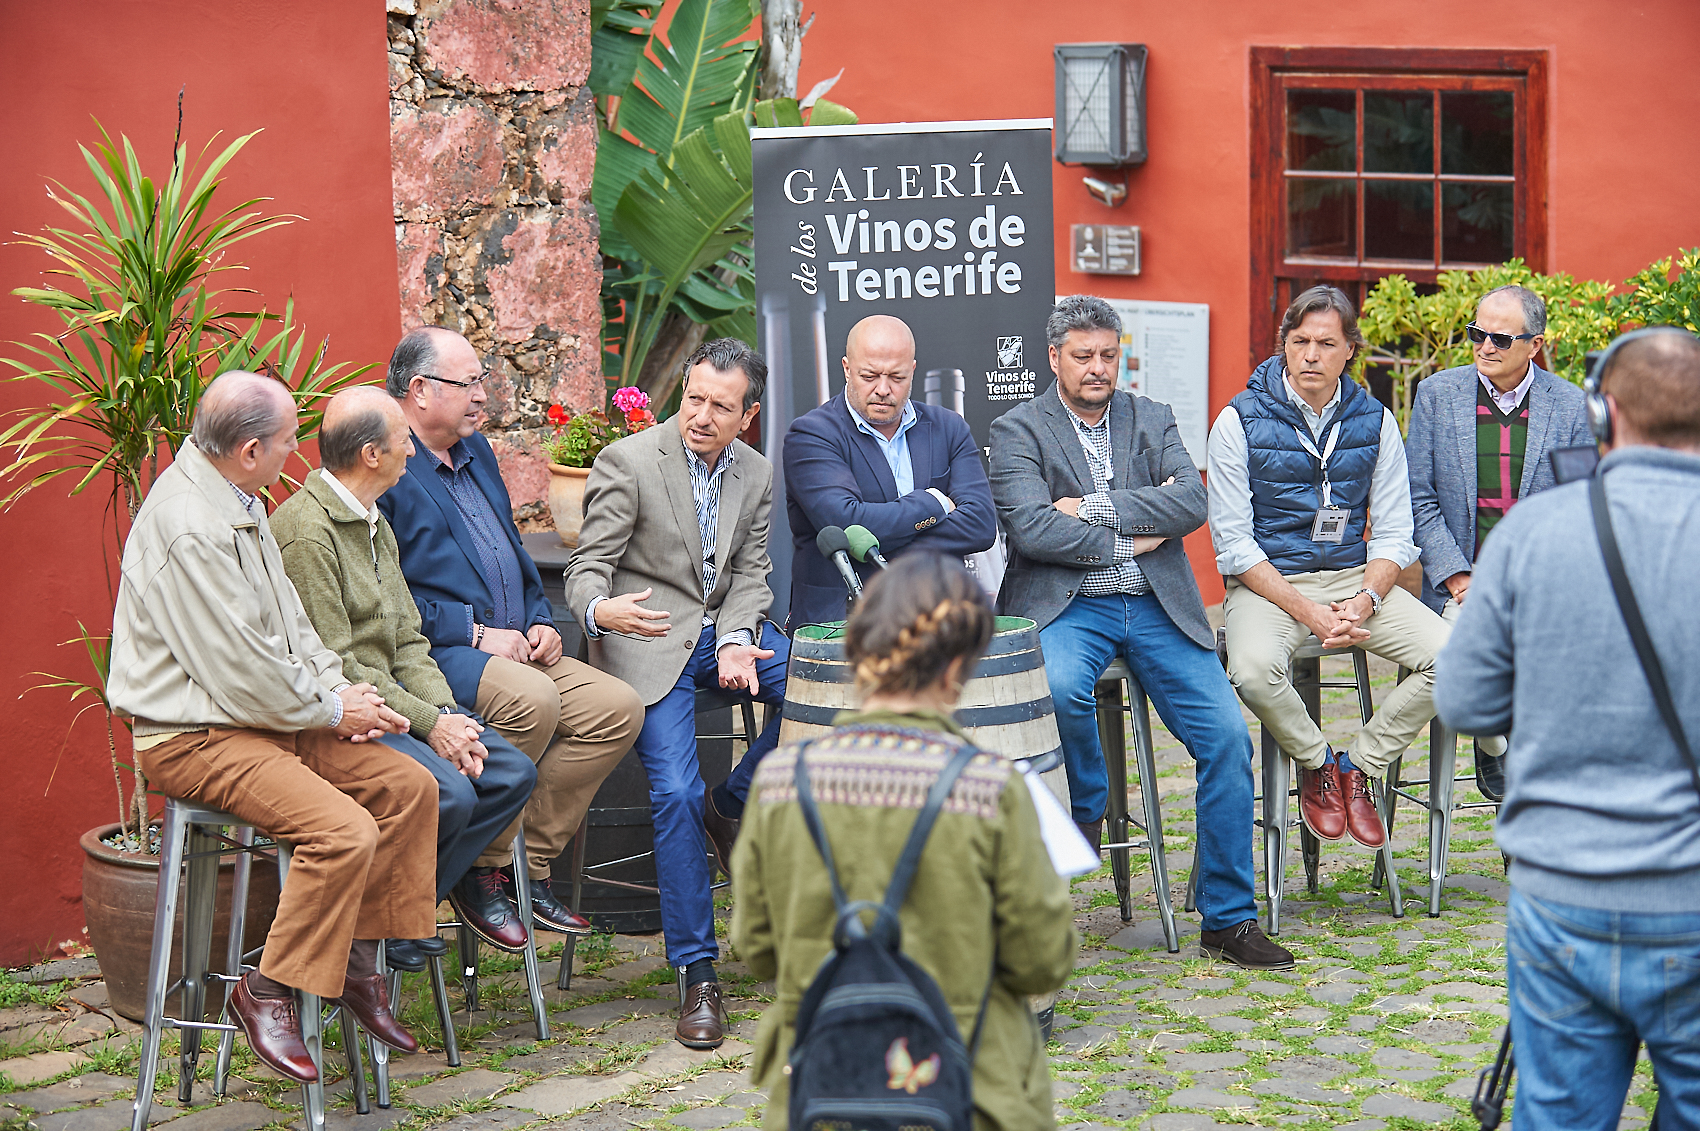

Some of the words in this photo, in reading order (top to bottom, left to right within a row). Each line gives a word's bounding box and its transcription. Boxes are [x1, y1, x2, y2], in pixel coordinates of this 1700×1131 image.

[783, 151, 1024, 205] GALERÍA
[790, 220, 816, 259] los
[824, 208, 957, 255] Vinos
[968, 204, 1026, 249] de
[791, 262, 818, 295] de
[827, 250, 1022, 302] Tenerife
[985, 370, 1020, 383] Vinos
[1020, 368, 1037, 381] de
[986, 380, 1036, 395] Tenerife
